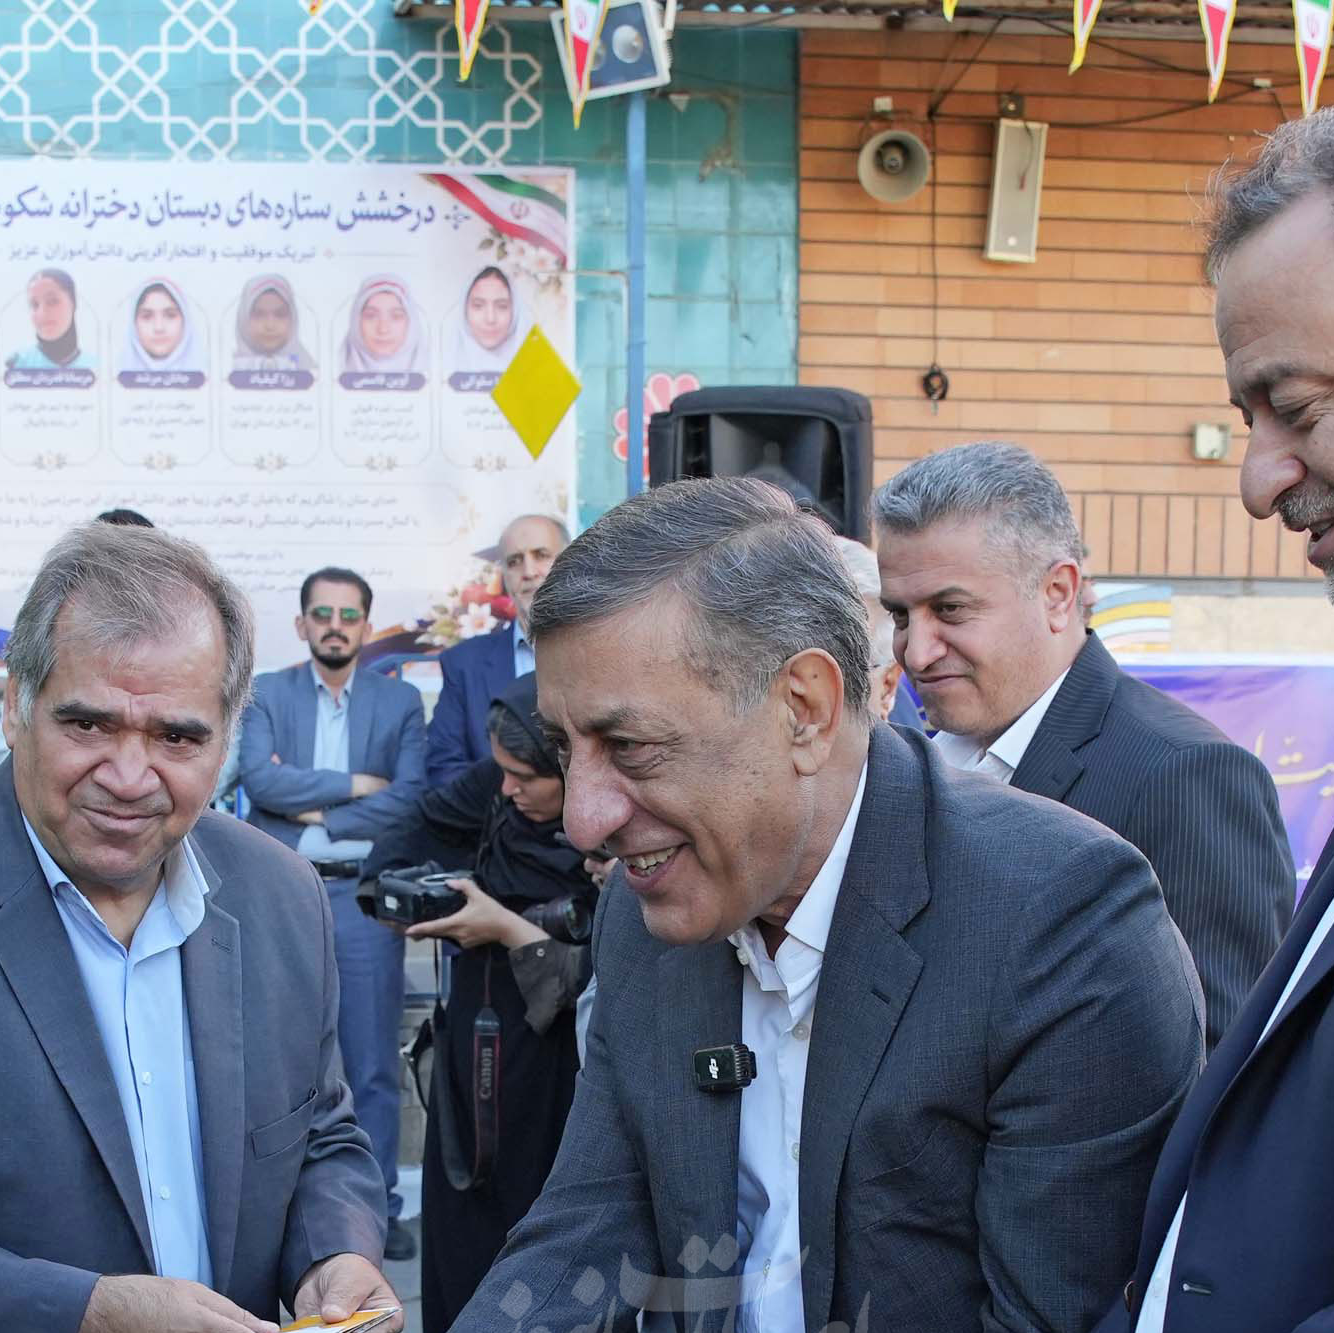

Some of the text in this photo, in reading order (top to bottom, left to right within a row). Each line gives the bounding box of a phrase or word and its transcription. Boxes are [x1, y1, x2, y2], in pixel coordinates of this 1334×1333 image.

[59, 187, 141, 229] دخترانه
[146, 188, 222, 227] دبستان
[336, 189, 435, 232] درخشش
[221, 246, 272, 263] موفقیت
[275, 246, 316, 263] تبریک
[479, 1047, 492, 1100] Canon
